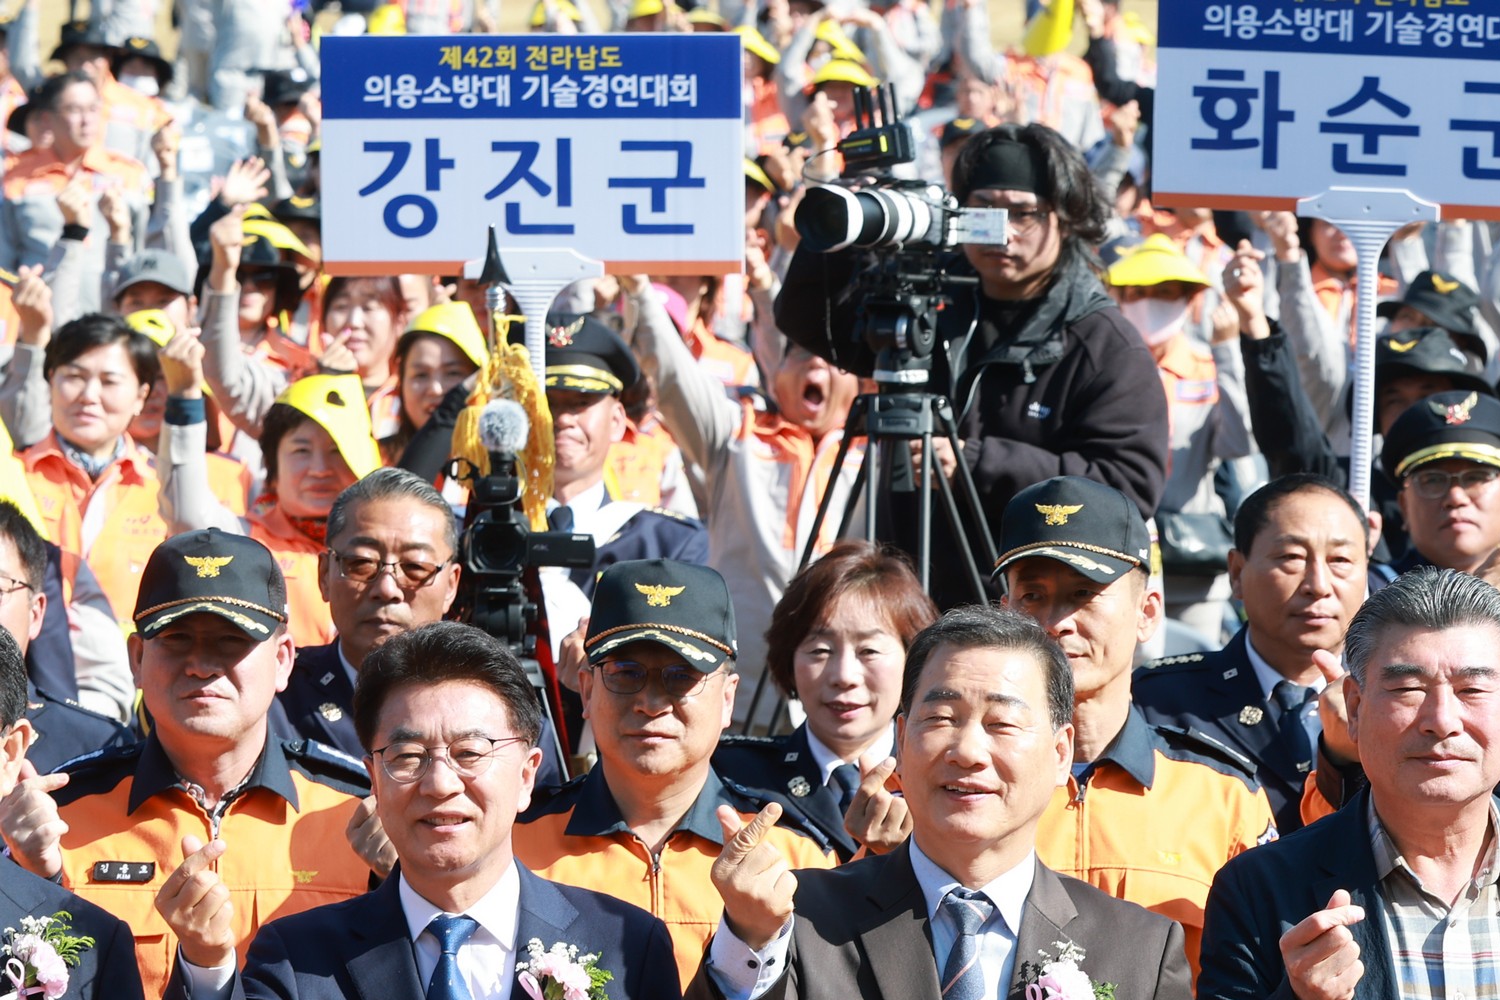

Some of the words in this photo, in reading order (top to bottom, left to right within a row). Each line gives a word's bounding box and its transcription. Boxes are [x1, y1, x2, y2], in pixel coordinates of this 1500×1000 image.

[1203, 5, 1354, 42] 의용소방대
[441, 45, 516, 70] 제42회
[526, 46, 622, 70] 전라남도
[363, 74, 511, 109] 의용소방대
[521, 74, 697, 109] 기술경연대회
[358, 137, 706, 238] 강진군
